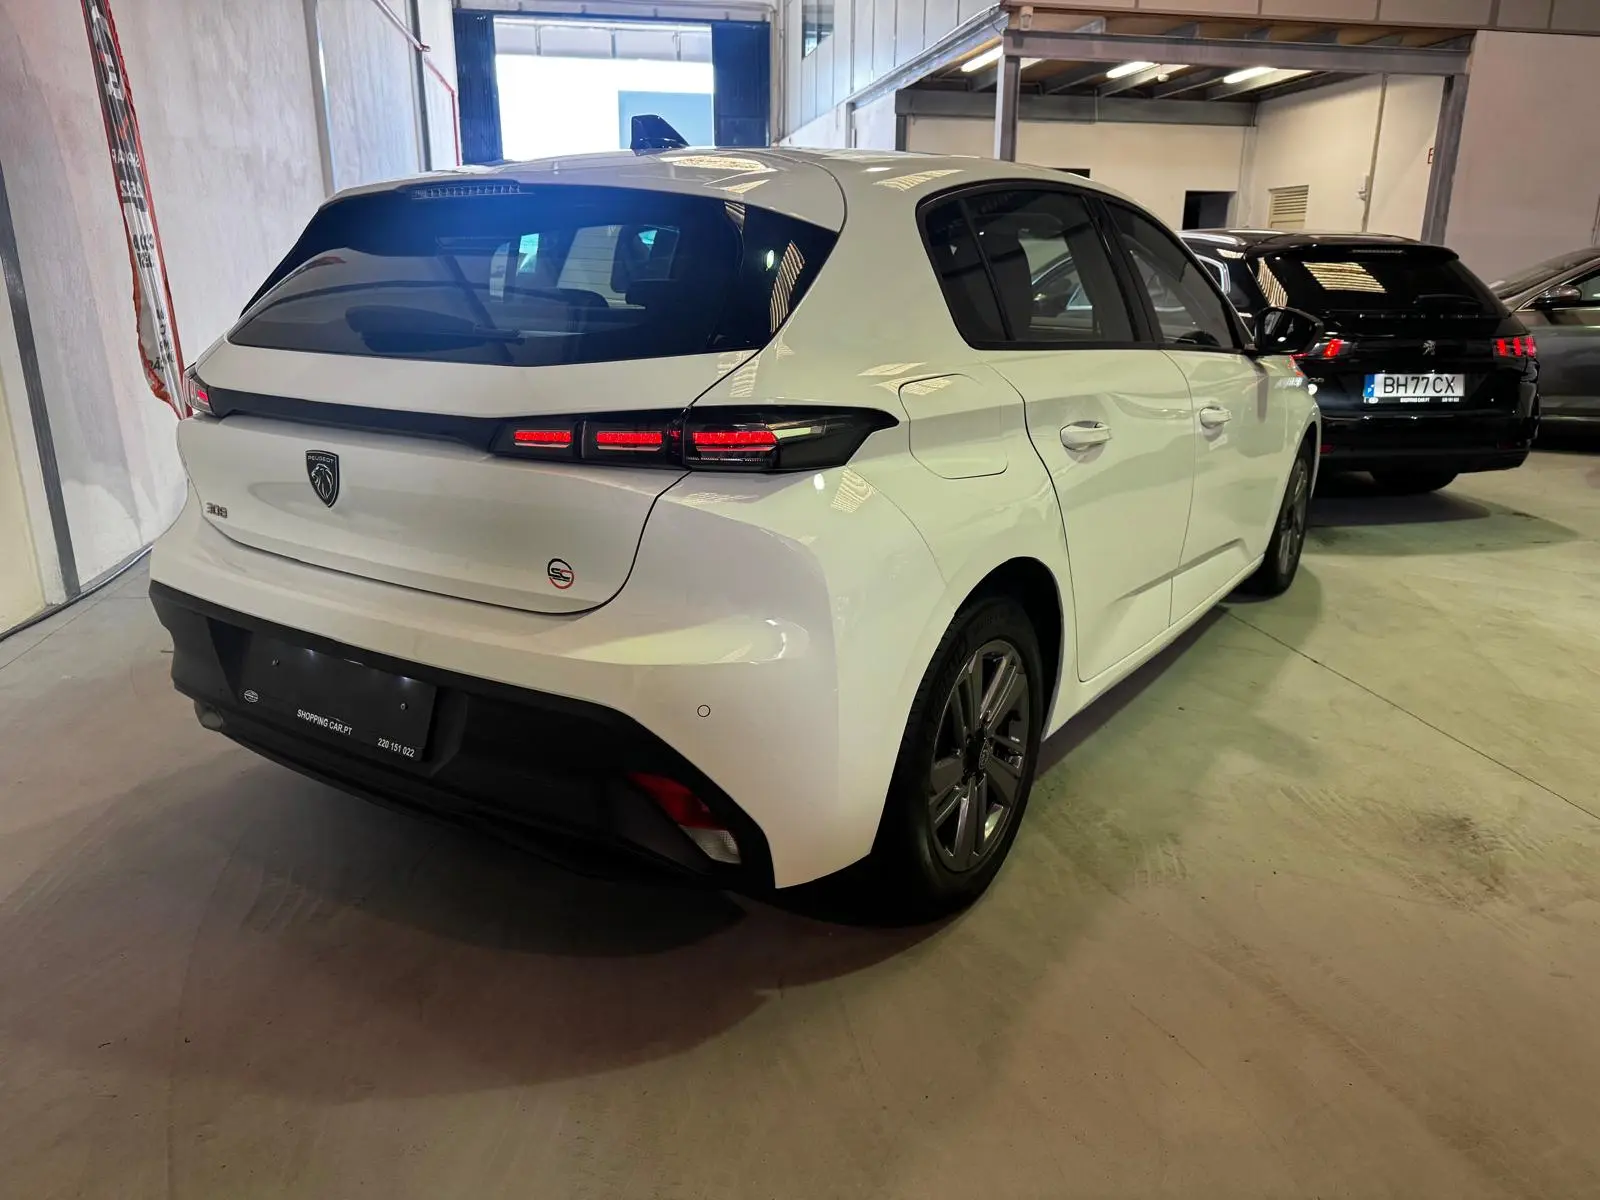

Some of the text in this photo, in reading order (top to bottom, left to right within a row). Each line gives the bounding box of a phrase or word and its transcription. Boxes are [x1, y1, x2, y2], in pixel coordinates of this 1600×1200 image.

[307, 455, 334, 464] PEUGEOT
[206, 502, 228, 519] 308
[296, 709, 353, 736] SHOPPING CAR.PT
[377, 738, 415, 758] 220 151 022
